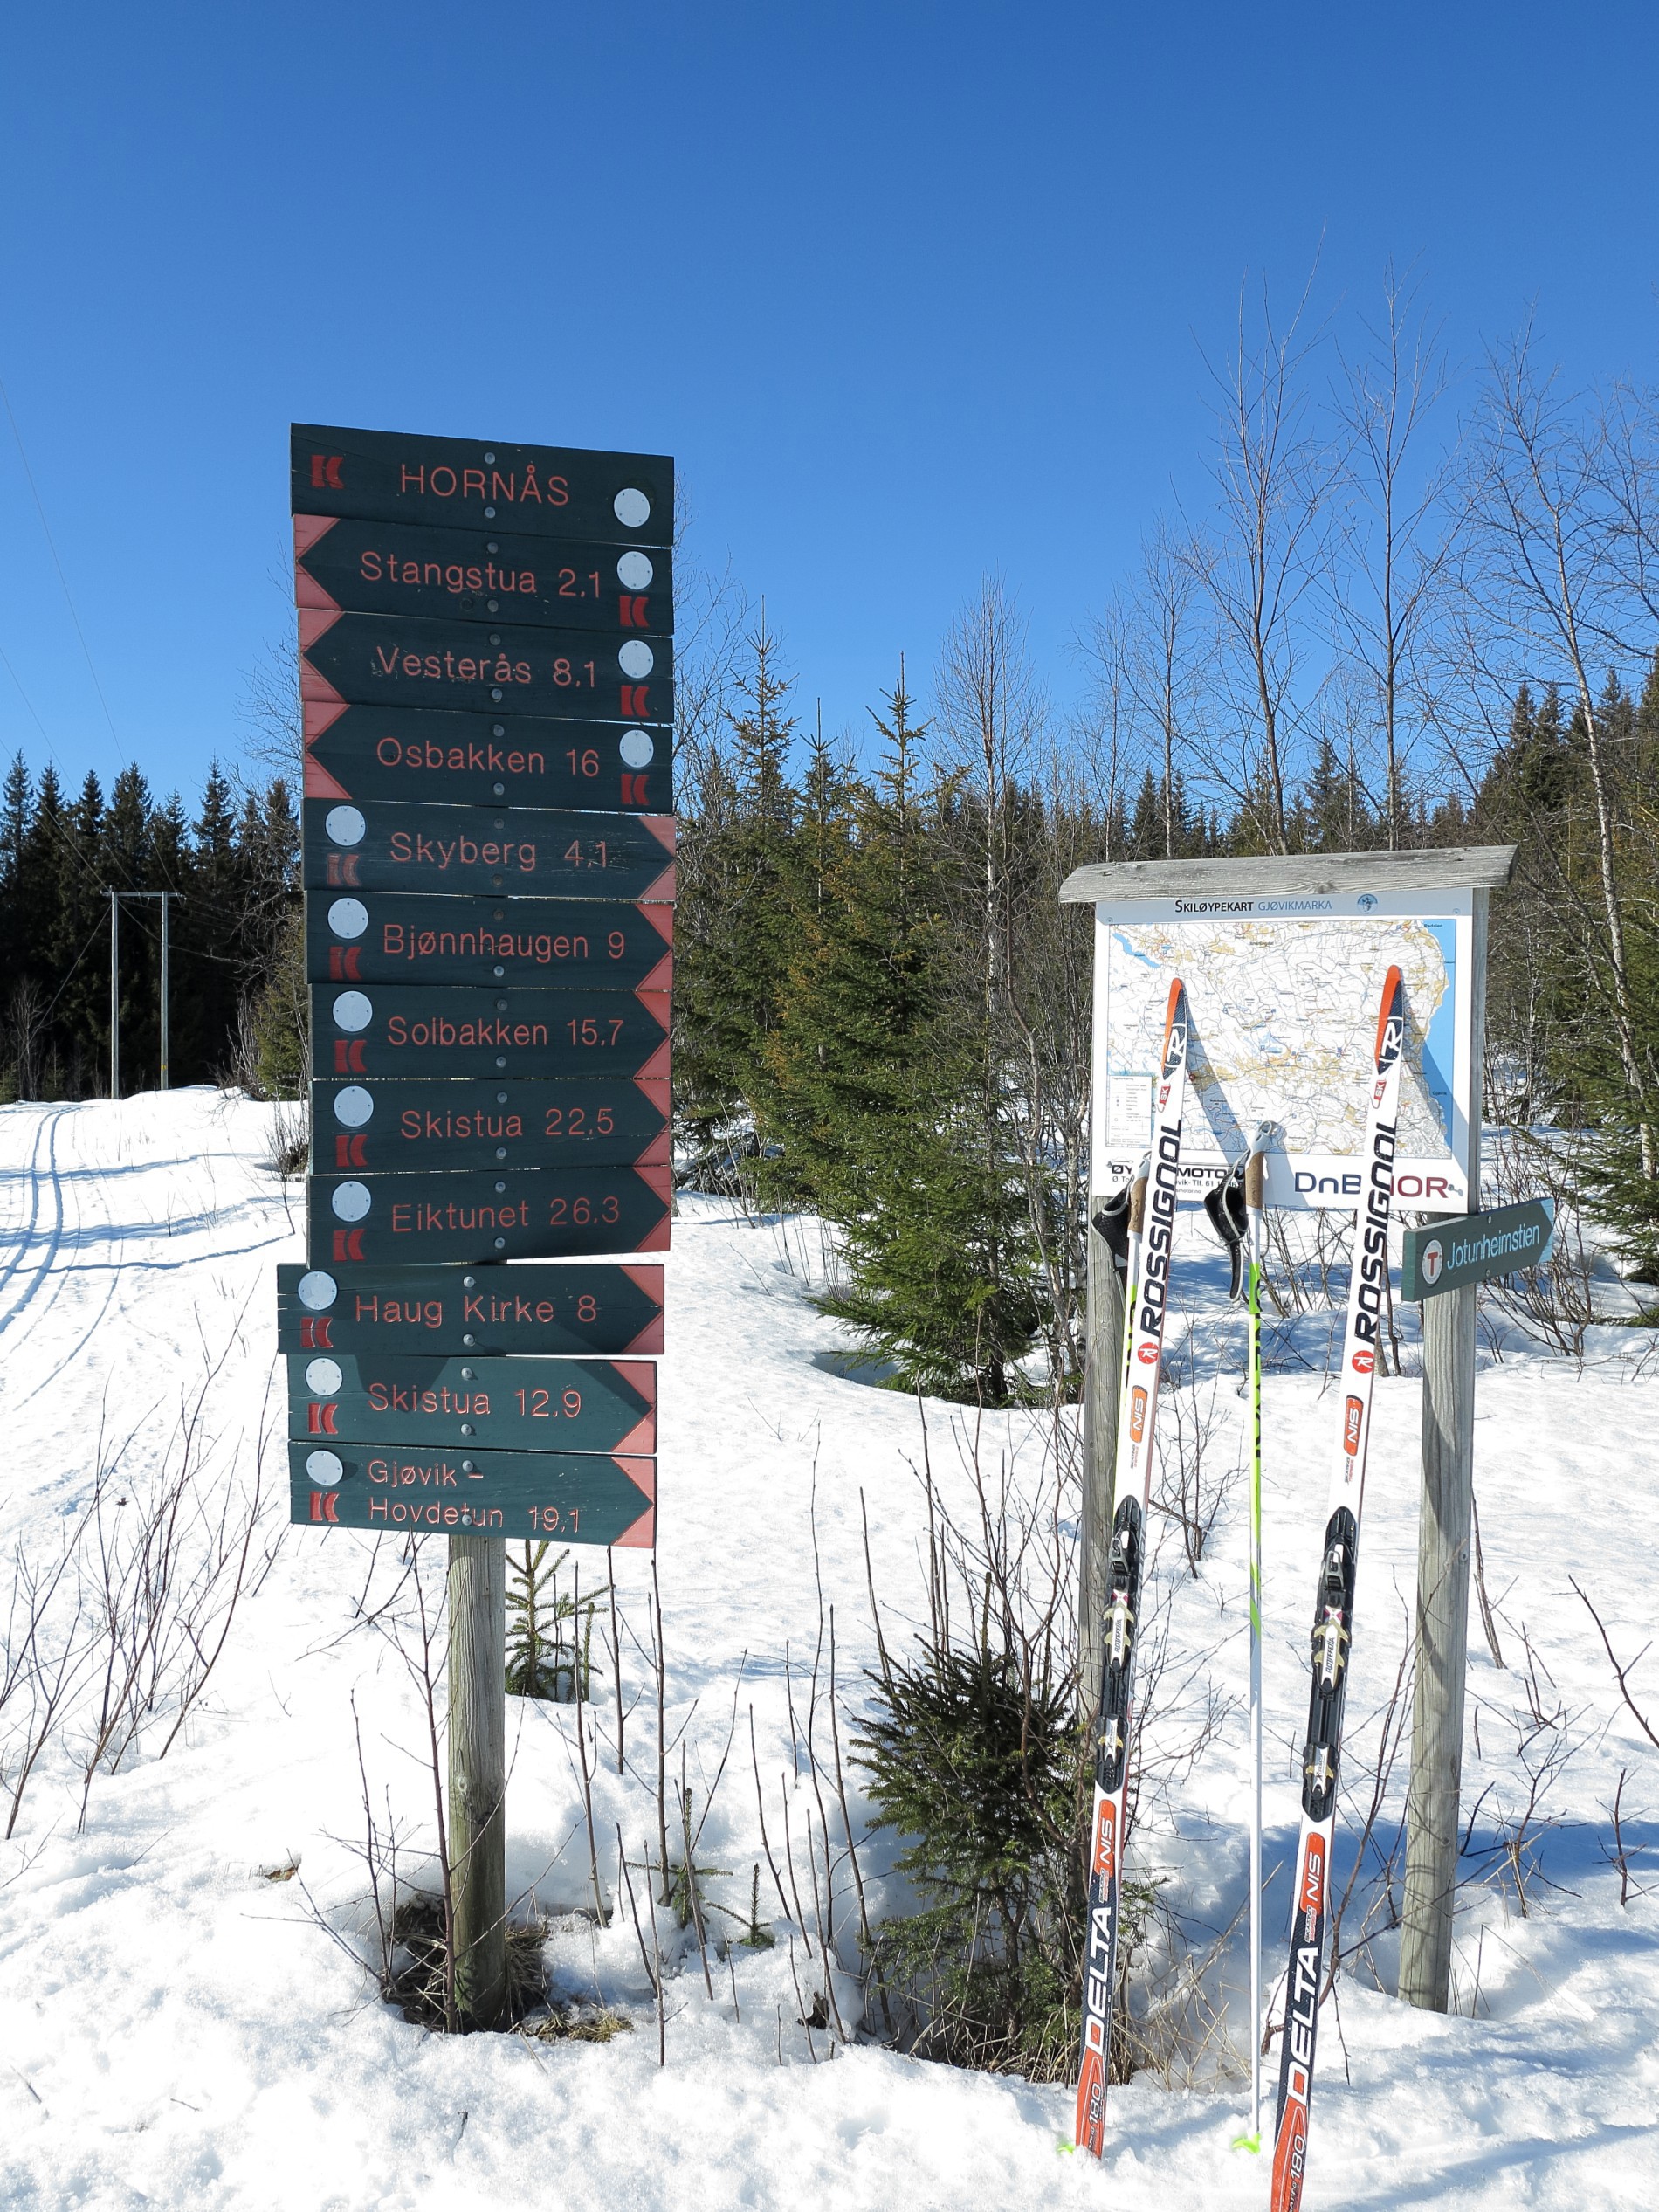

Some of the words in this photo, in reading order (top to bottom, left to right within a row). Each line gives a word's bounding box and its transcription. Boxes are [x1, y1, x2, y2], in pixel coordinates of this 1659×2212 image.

[402, 464, 568, 506] HORNÅS
[361, 551, 535, 593] Stangstua
[559, 568, 599, 596] 2,1
[377, 648, 529, 684] Vesterås
[554, 658, 594, 686] 8,1
[376, 737, 544, 772] Osbakken
[568, 748, 598, 777] 16
[389, 831, 536, 872] Skyberg
[564, 839, 608, 868] 4,1
[1175, 899, 1254, 913] SKILØYPEKART
[1258, 901, 1332, 911] GJØVIKMARKA
[384, 924, 588, 963] Bjønnhaugen
[608, 931, 625, 959] 9
[388, 1016, 547, 1045] Solbakken
[568, 1019, 623, 1046] 15,7
[402, 1110, 522, 1139] Skistua
[545, 1107, 614, 1136] 22,5
[1177, 1168, 1234, 1179] MOTO
[1295, 1172, 1361, 1194] DnB
[392, 1202, 527, 1232] Eiktunet
[550, 1196, 617, 1225] 26,3
[1139, 1119, 1181, 1338] ROSSIGNOL
[1354, 1116, 1397, 1345] ROSSIGNOL
[1448, 1223, 1539, 1270] Jotunheimstien
[355, 1296, 442, 1328] Haug
[464, 1296, 553, 1323] Kirke
[577, 1294, 596, 1322] 8
[368, 1382, 490, 1415] Skistua
[516, 1388, 581, 1418] 12,9
[1132, 1398, 1143, 1431] NIS
[1346, 1409, 1359, 1444] NIS
[368, 1459, 457, 1487] Gjøvik
[369, 1496, 504, 1528] Hovdetun
[529, 1506, 578, 1532] 19,1
[1099, 1819, 1114, 1864] NIS
[1307, 1851, 1322, 1902] NIS
[1084, 1906, 1111, 2056] DELTA
[1288, 1947, 1318, 2106] DELTA
[1089, 2082, 1101, 2125] 180
[1291, 2133, 1304, 2179] 180
